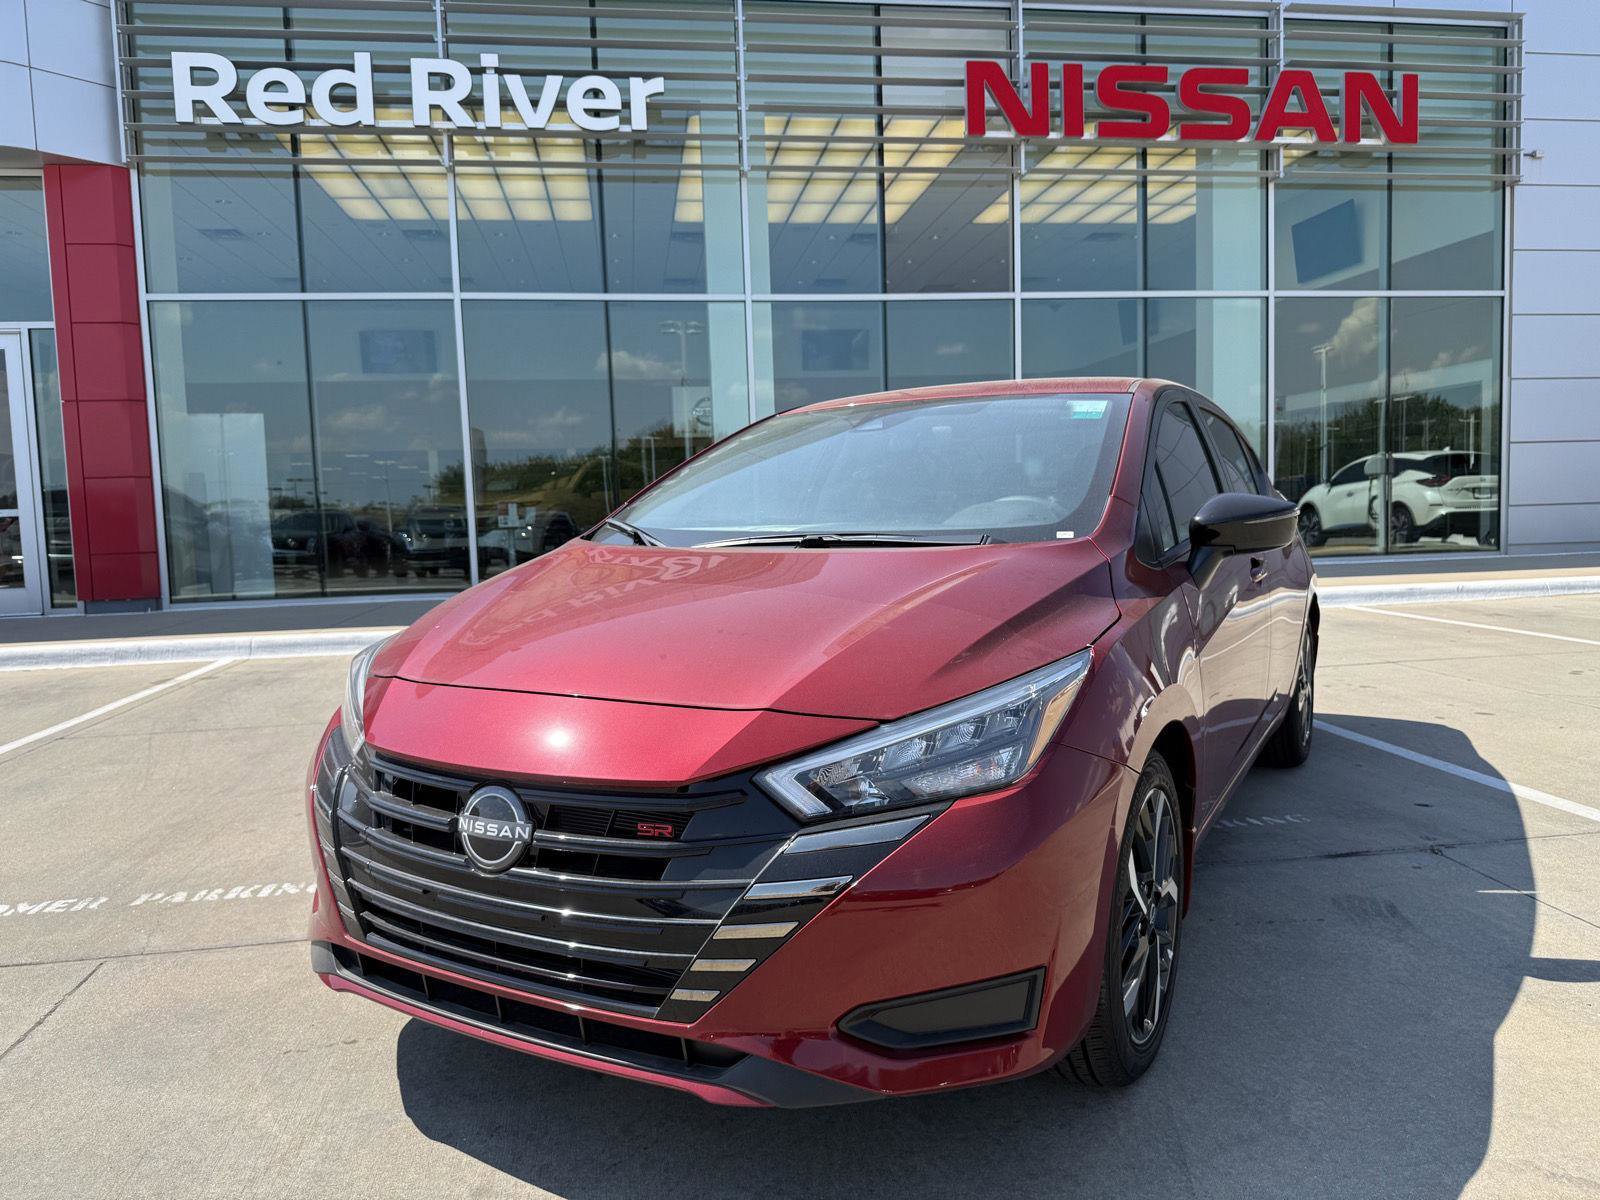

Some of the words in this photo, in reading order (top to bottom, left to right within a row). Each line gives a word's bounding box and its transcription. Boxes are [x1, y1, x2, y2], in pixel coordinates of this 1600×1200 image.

[171, 51, 376, 127] Red
[410, 53, 665, 131] River
[964, 60, 1419, 144] NISSAN
[458, 817, 530, 840] NISSAN
[637, 822, 673, 838] SR
